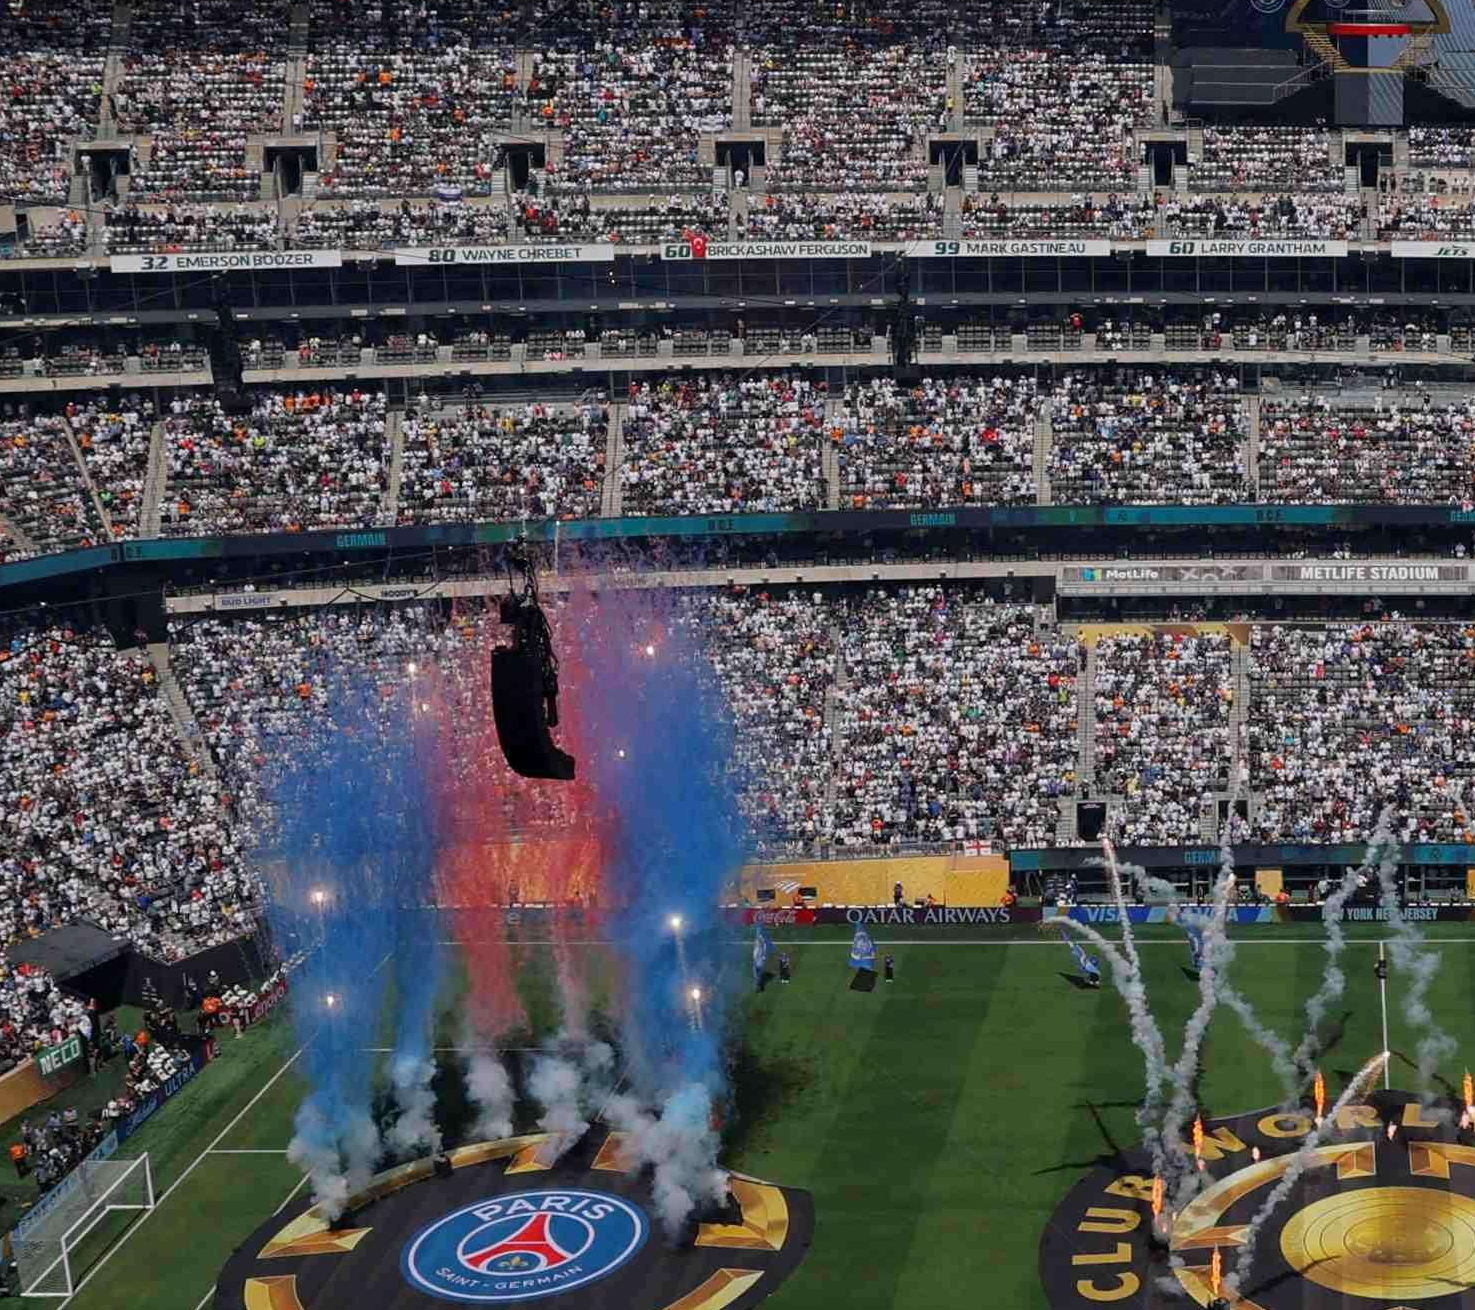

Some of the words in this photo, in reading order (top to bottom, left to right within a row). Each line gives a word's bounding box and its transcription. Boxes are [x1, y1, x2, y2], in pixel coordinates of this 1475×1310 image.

[428, 249, 456, 263] 80
[462, 248, 515, 261] WAYNE
[517, 246, 582, 260] CHREBET
[664, 245, 691, 259] 60
[798, 243, 868, 256] FERGUSON
[934, 242, 960, 255] 99
[966, 242, 1005, 255] MARK
[1008, 242, 1086, 255] GASTINEAU
[1169, 242, 1195, 255] 60
[1200, 242, 1244, 255] LARRY
[1247, 242, 1326, 255] GRANTHAM
[141, 256, 169, 270] 32
[176, 254, 250, 269] EMERSON
[252, 252, 314, 267] BOOZER
[336, 531, 387, 547] GERMAIN
[1105, 569, 1159, 580] MetLife
[1300, 565, 1367, 581] METLIFE
[1369, 565, 1440, 581] STADIUM
[845, 907, 914, 925] QATAR
[924, 907, 1011, 924] AIRWAYS
[469, 1195, 616, 1222] PARIS
